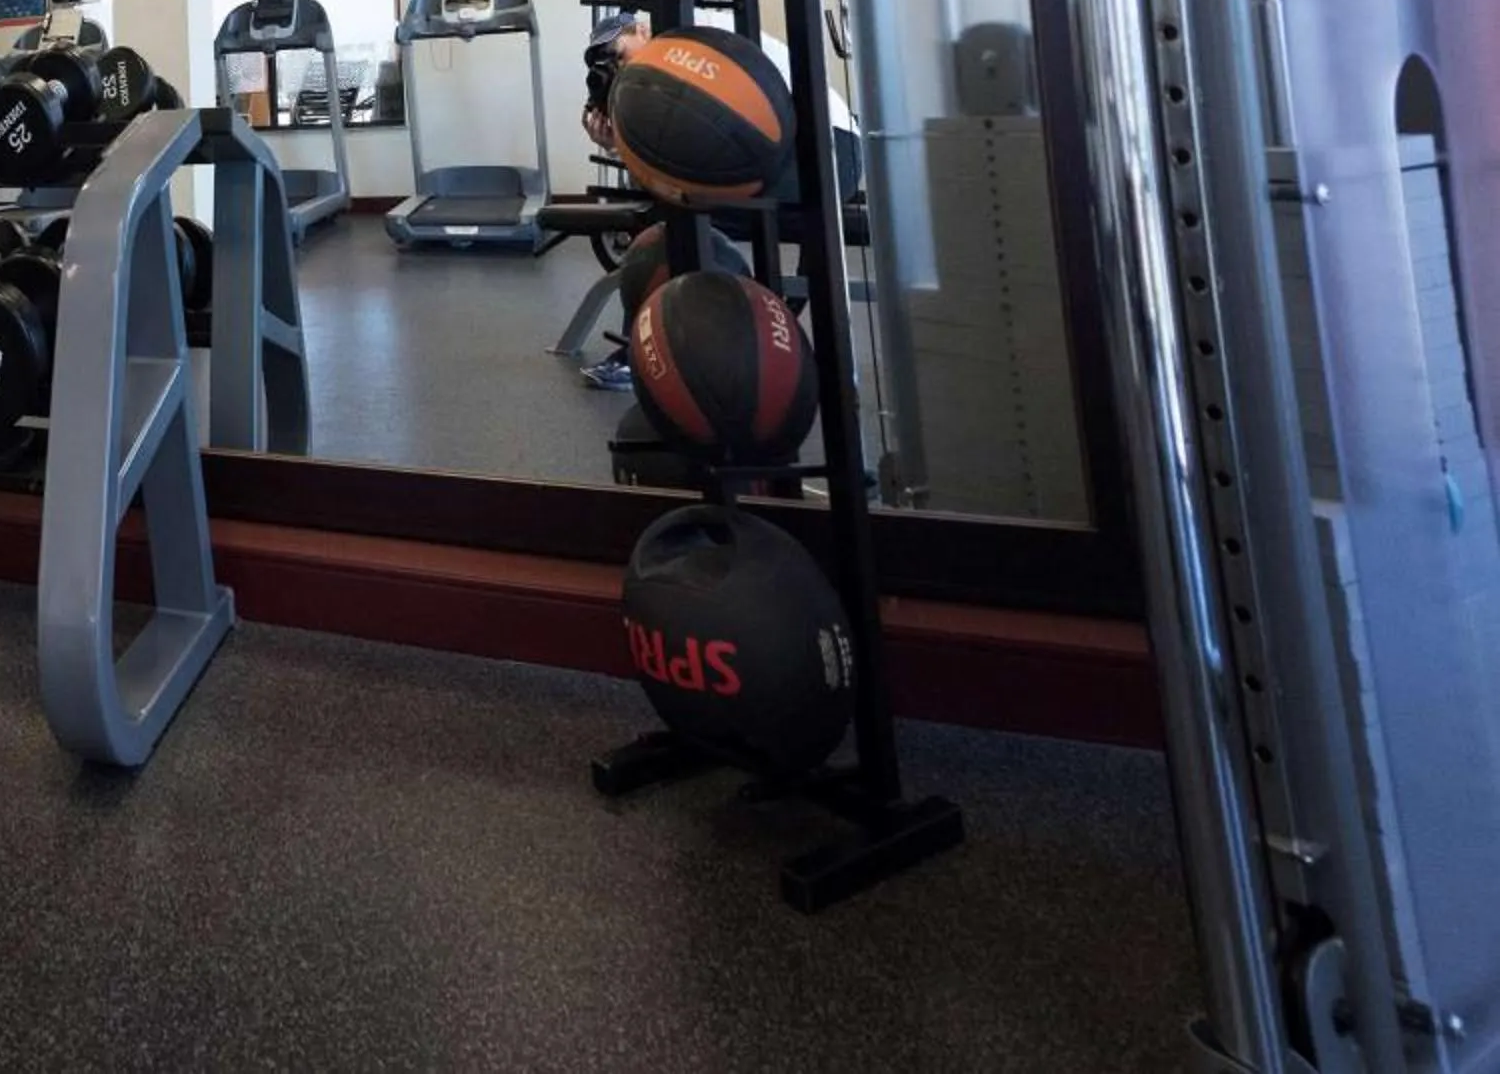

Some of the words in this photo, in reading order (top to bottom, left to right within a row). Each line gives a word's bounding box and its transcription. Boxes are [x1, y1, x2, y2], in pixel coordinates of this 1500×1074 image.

[663, 47, 720, 79] SPRI
[8, 122, 33, 154] 25
[762, 294, 791, 353] SPRI
[629, 621, 741, 695] SPRI
